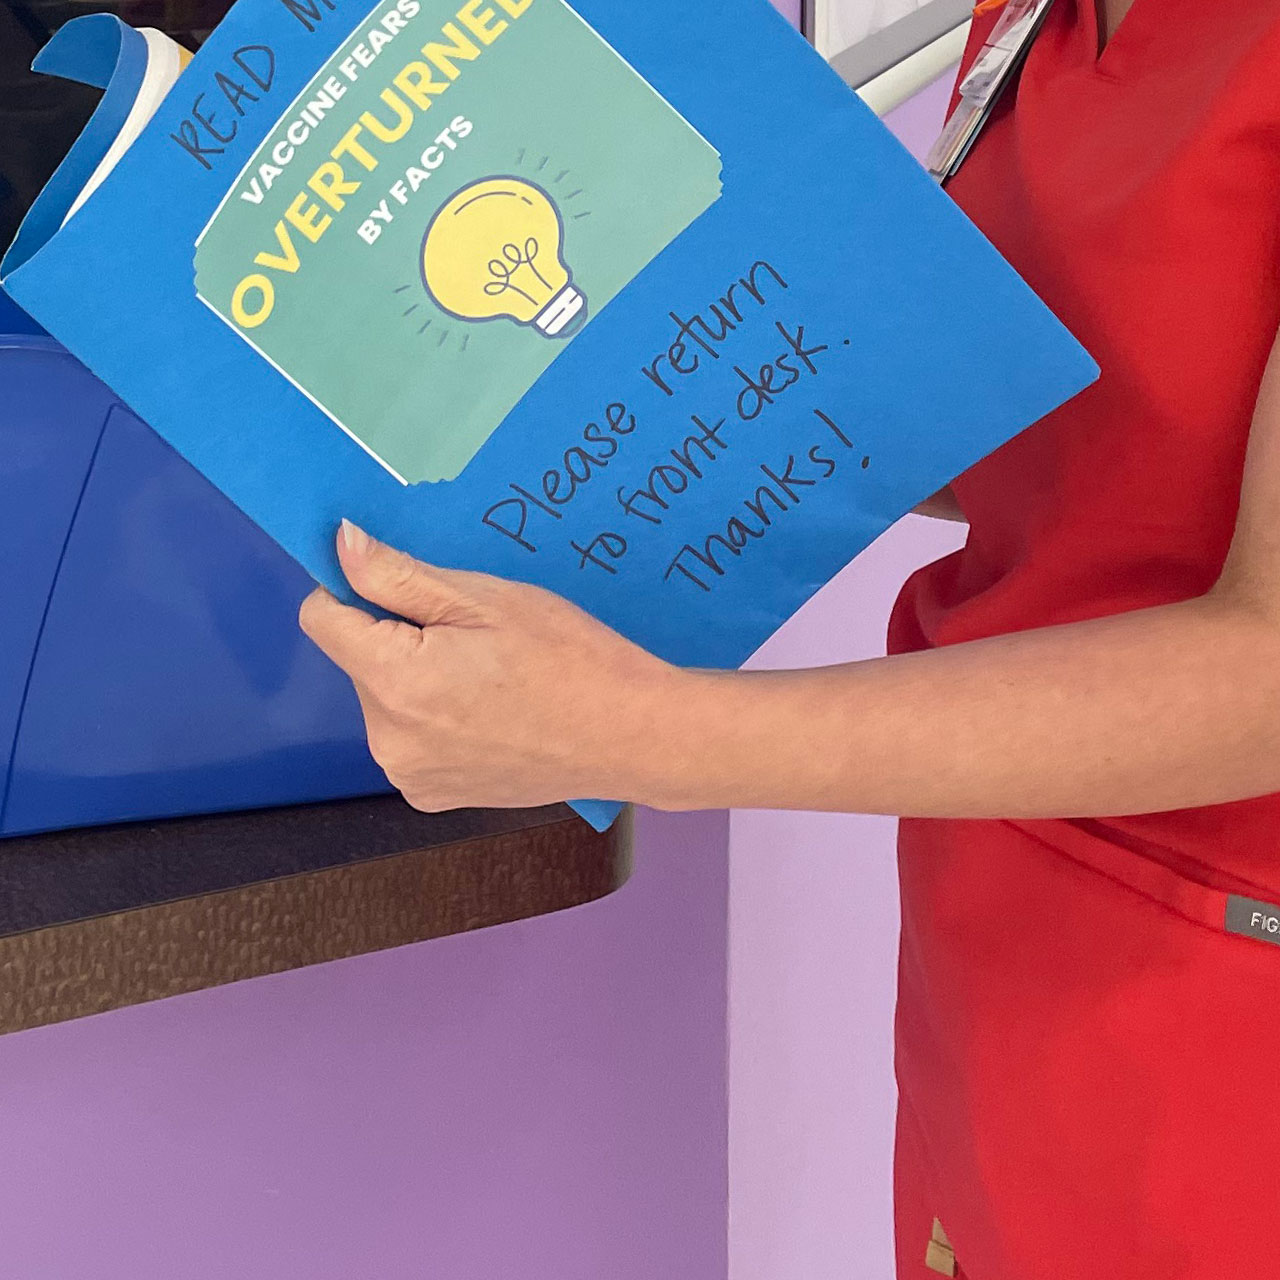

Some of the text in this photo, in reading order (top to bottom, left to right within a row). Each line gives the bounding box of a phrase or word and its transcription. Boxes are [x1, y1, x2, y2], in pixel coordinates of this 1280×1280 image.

[170, 45, 275, 170] READ
[241, 76, 347, 205] VACCINE
[357, 115, 473, 245] BY FACTS
[483, 261, 788, 552] Please return
[570, 532, 627, 574] to
[617, 416, 728, 524] front
